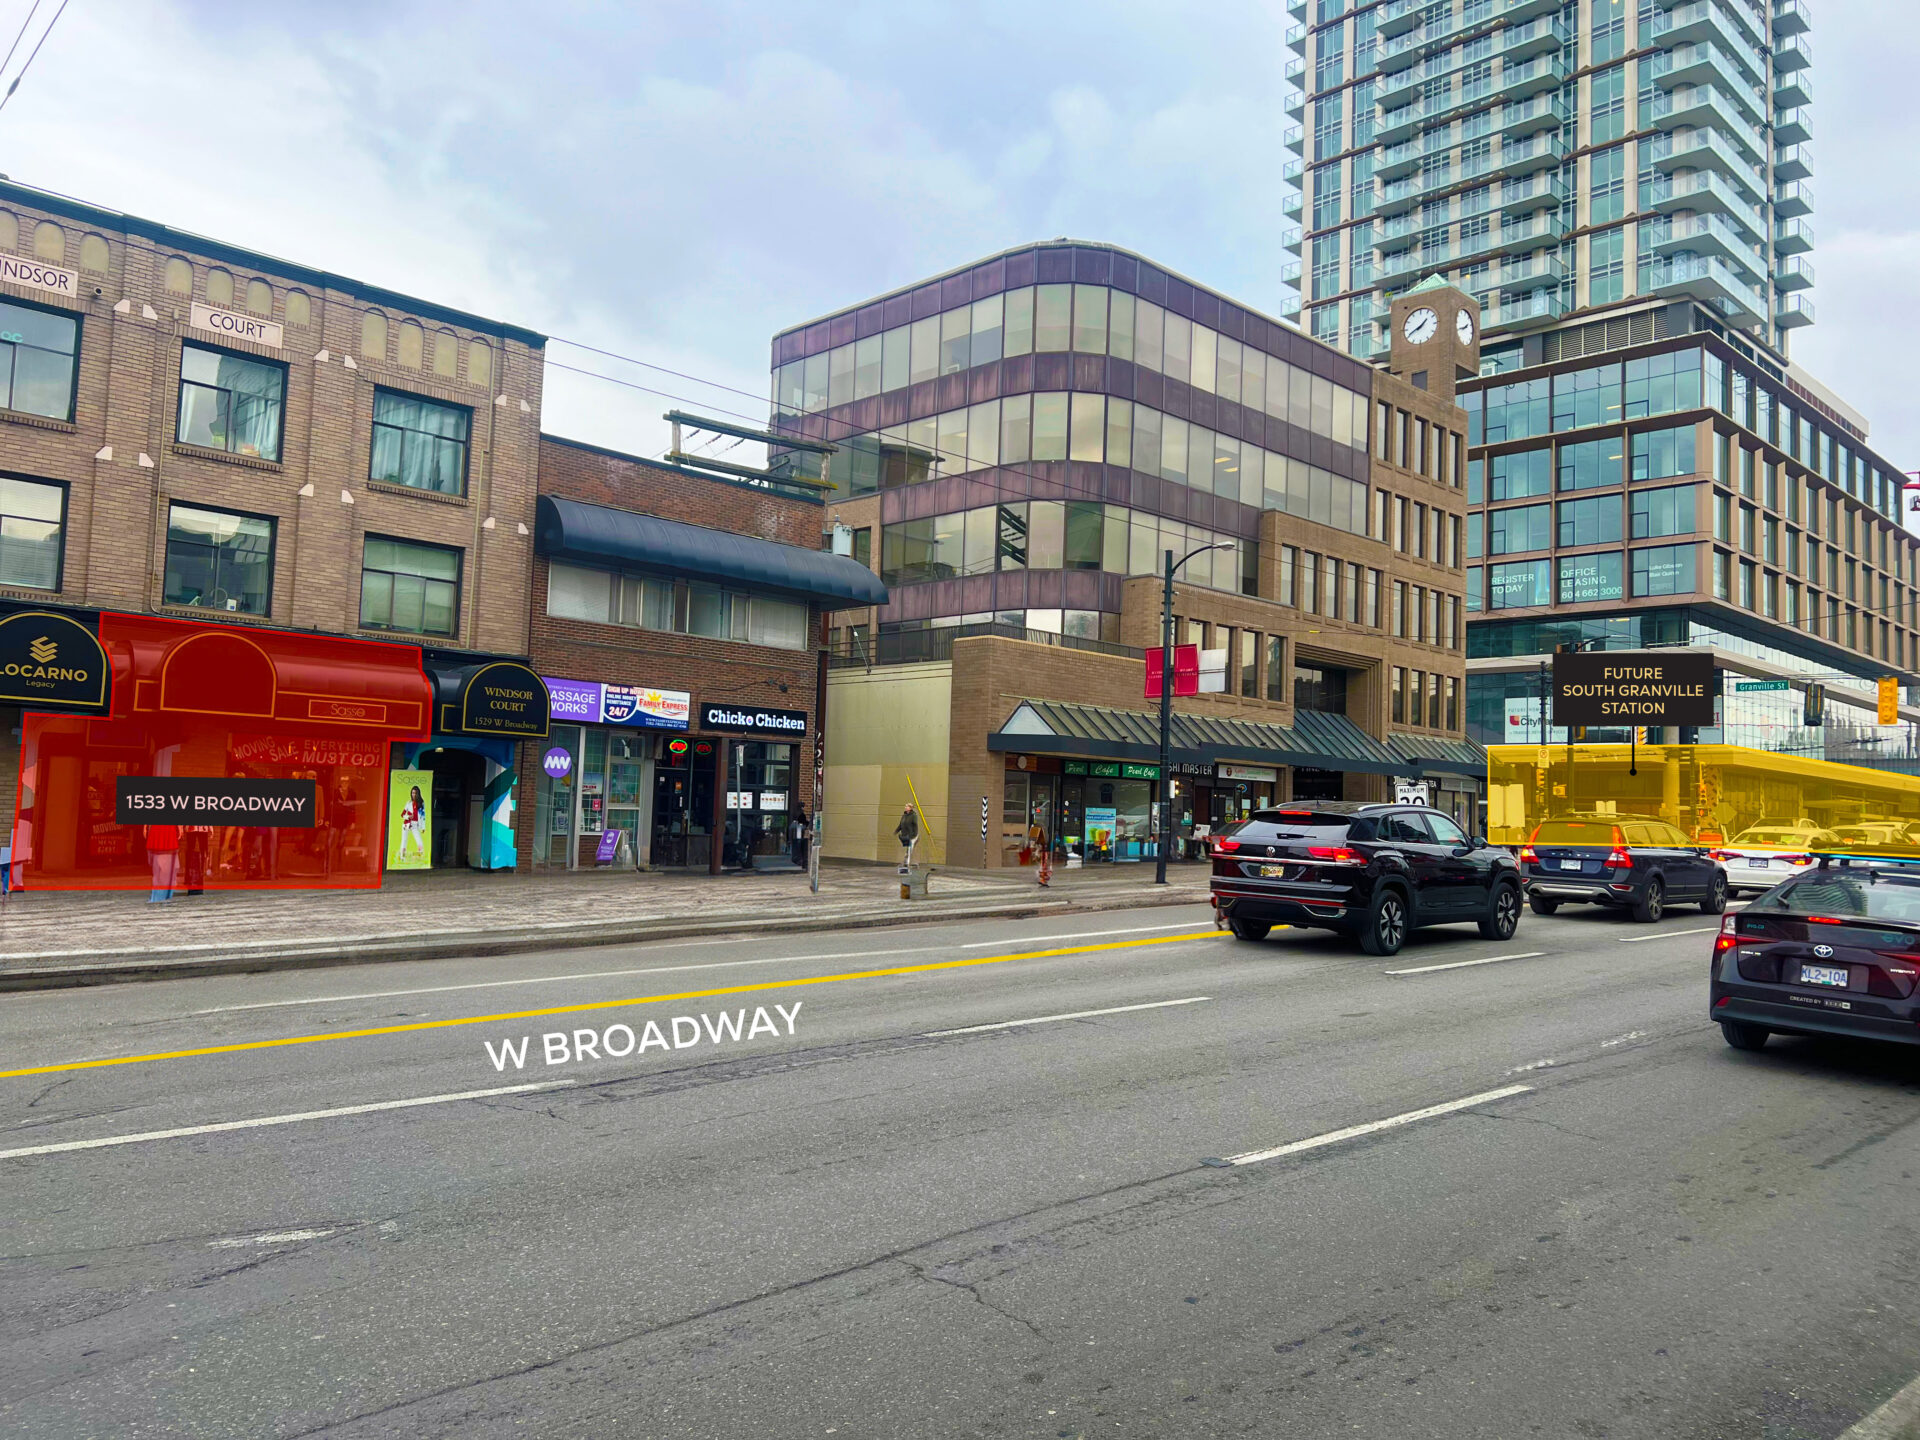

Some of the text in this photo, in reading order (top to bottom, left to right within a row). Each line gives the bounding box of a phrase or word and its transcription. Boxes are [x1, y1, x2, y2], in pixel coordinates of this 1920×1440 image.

[209, 313, 266, 338] COURT
[1561, 567, 1597, 578] OFFICE
[1492, 573, 1535, 585] REGISTER
[1562, 576, 1607, 588] LEASING
[1492, 584, 1524, 594] TODAY
[1562, 586, 1623, 599] 604 662 3000
[25, 680, 55, 689] Legacy
[1739, 681, 1785, 691] Granville St
[484, 687, 533, 700] WINDSOR
[550, 690, 596, 704] ASSAGE
[330, 703, 366, 718] Sasse
[490, 700, 527, 712] COURT
[639, 698, 661, 709] FAMILY
[662, 700, 688, 712] EXPRESS
[608, 706, 629, 717] 24/7
[475, 716, 538, 731] 1529 W Broadway
[708, 709, 805, 730] Chicko Chicken
[232, 736, 299, 762] MOVING SALE
[304, 739, 381, 753] EVERYTHING
[302, 751, 380, 767] MUST GO!
[1128, 766, 1156, 778] Pearl Cafe
[1182, 763, 1213, 775] MASTER
[396, 773, 427, 785] Sasse
[1790, 995, 1813, 1004] CREATED
